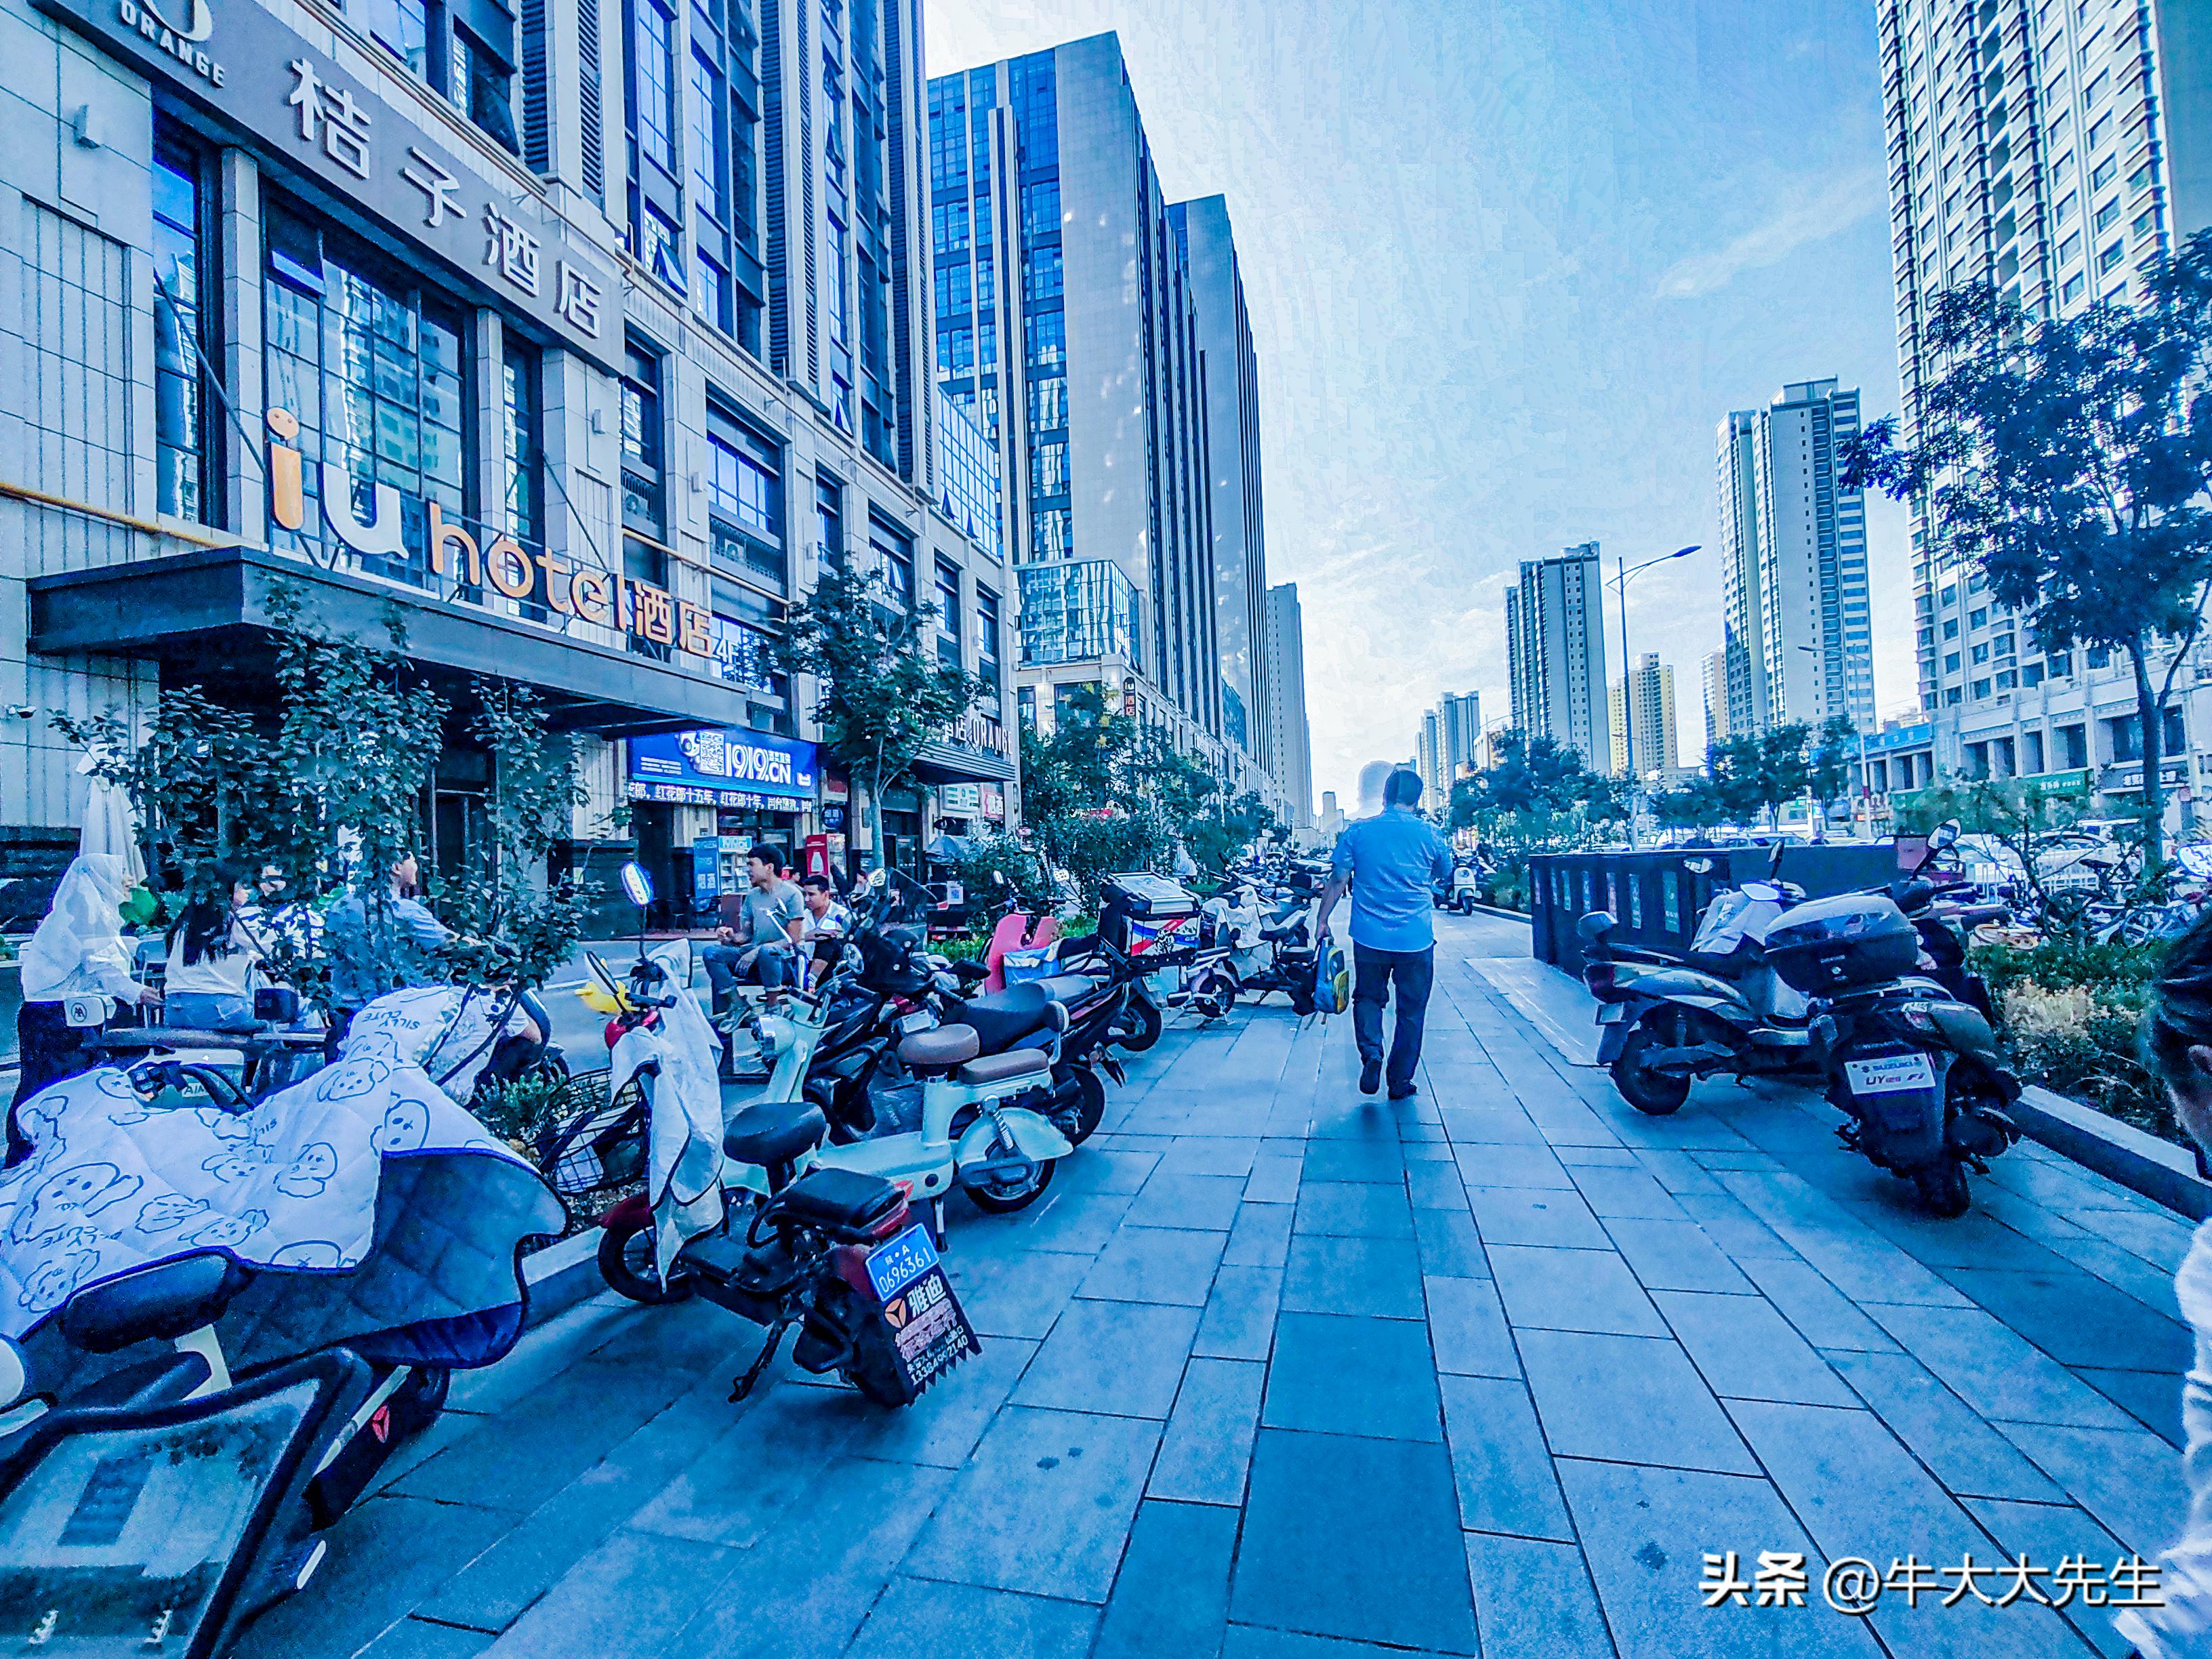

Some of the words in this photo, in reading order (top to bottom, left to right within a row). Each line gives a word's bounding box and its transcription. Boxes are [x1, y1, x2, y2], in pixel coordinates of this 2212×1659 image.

[120, 0, 226, 88] ORANGE
[290, 58, 602, 339] 桔子酒店
[428, 501, 627, 631] hotel
[634, 581, 713, 657] 酒店
[972, 718, 1012, 755] ORANGE
[878, 1246, 931, 1293] 0696361
[906, 1273, 947, 1319] 雅迪
